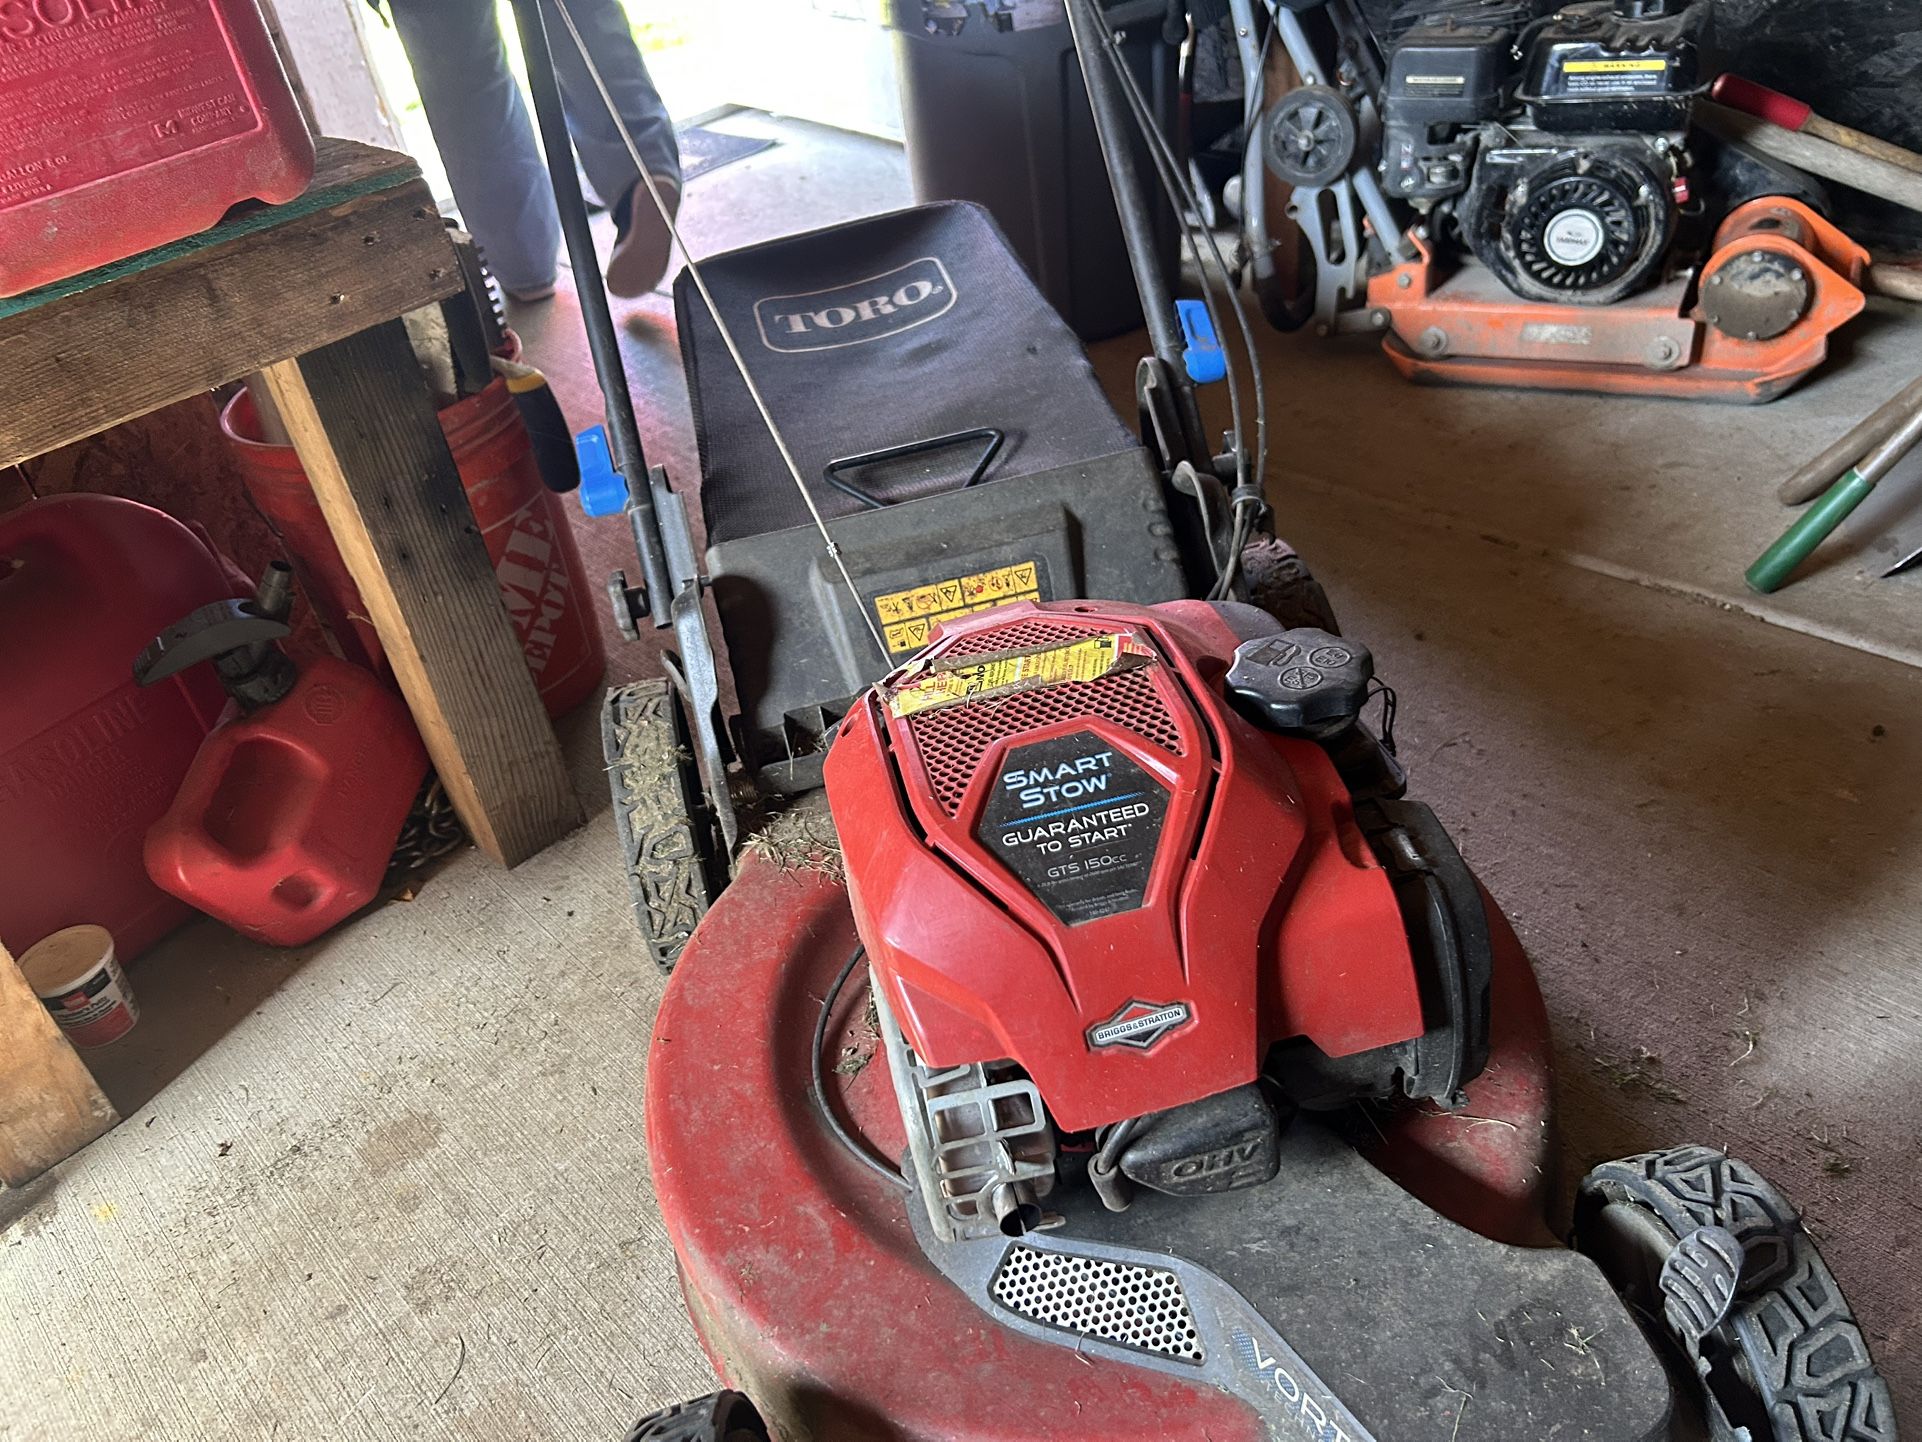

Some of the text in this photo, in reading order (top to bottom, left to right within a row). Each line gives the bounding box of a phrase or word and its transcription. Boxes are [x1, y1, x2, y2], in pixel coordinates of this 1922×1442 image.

[774, 280, 933, 334] TORO
[1003, 752, 1113, 791] SMART
[1020, 776, 1110, 809] STOW
[1002, 803, 1149, 847] GUARANTEED
[1037, 840, 1063, 855] TO
[1047, 862, 1080, 878] GTS
[1172, 1136, 1264, 1178] OHV
